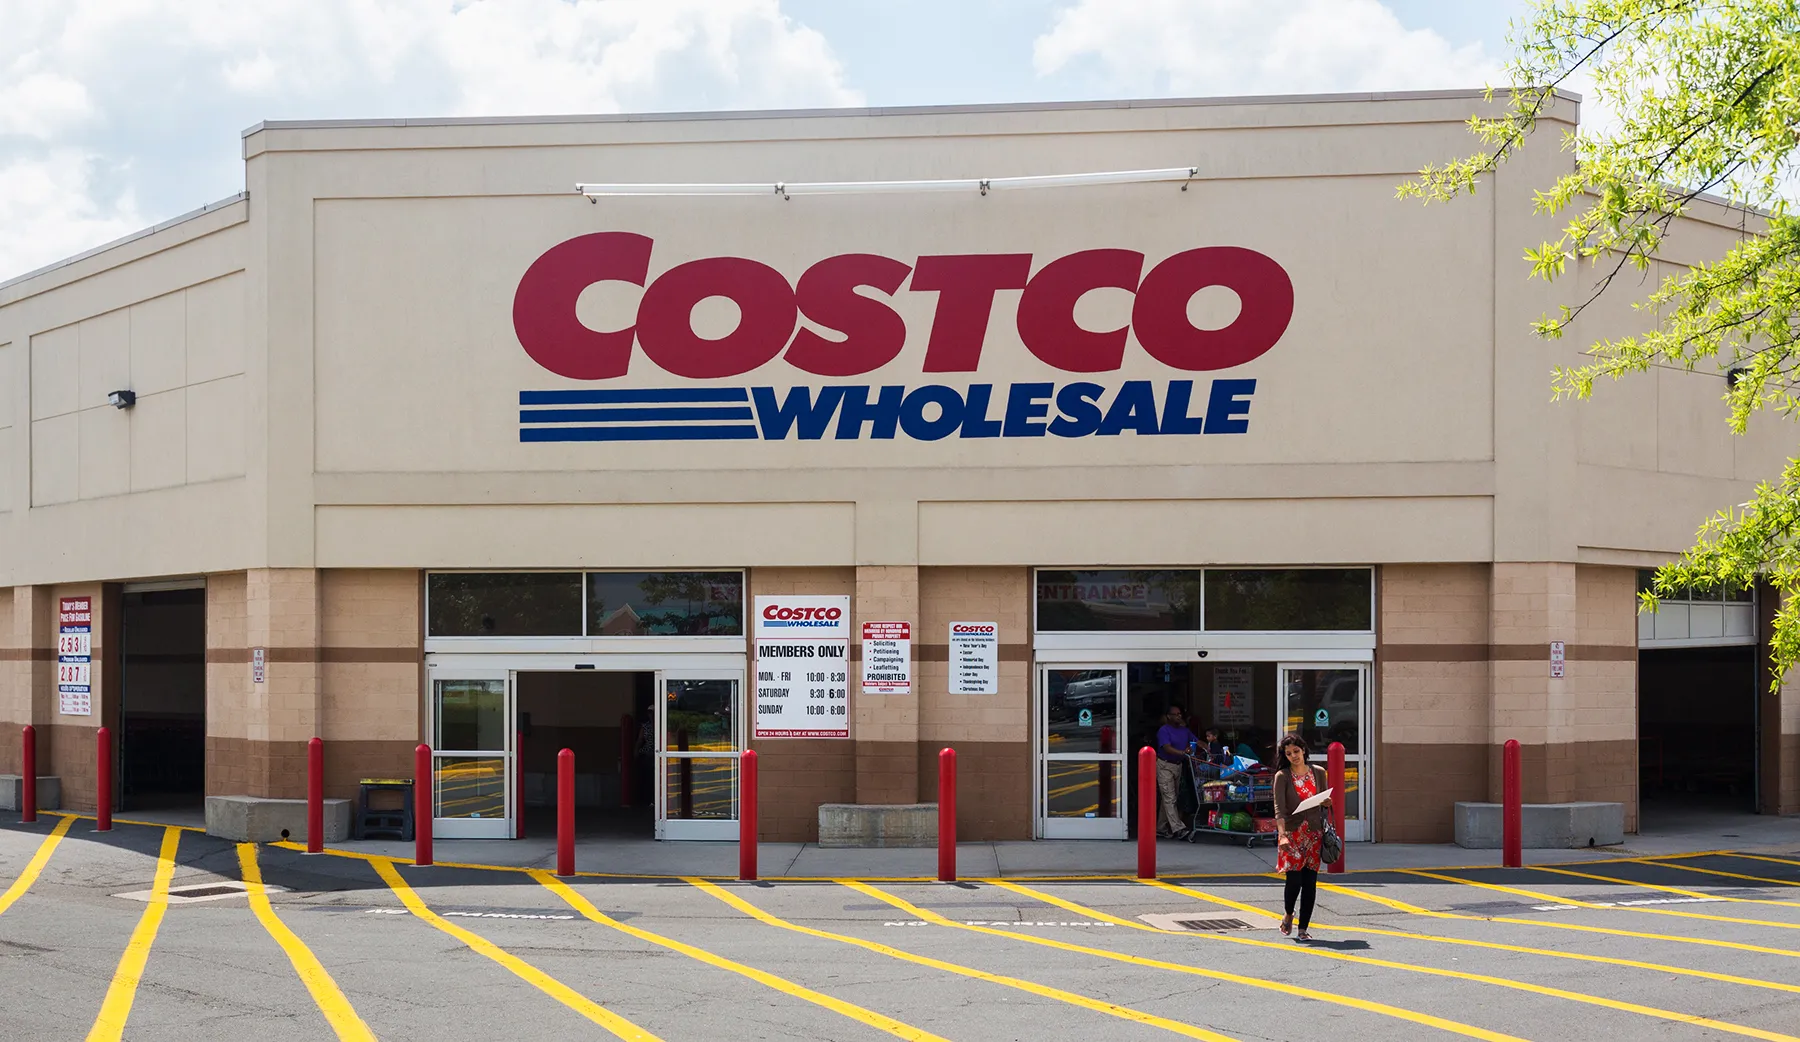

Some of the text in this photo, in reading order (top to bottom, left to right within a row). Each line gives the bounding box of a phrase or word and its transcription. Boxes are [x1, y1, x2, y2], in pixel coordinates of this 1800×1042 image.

[513, 231, 1294, 380] COSTCO
[749, 378, 1257, 440] WHOLESALE
[763, 605, 841, 620] COSTCO
[953, 624, 994, 632] COSTCO
[760, 646, 845, 658] MEMBERS ONLY
[759, 672, 775, 681] MON.
[781, 672, 791, 681] FRI
[806, 672, 824, 682] 10:00
[831, 672, 845, 682] 8:30
[758, 688, 789, 698] SATURDAY
[810, 689, 824, 698] 9:30
[829, 689, 845, 698] 6:00
[758, 705, 783, 714] SUNDAY
[806, 706, 824, 715] 10:00
[830, 706, 845, 715] 6:00
